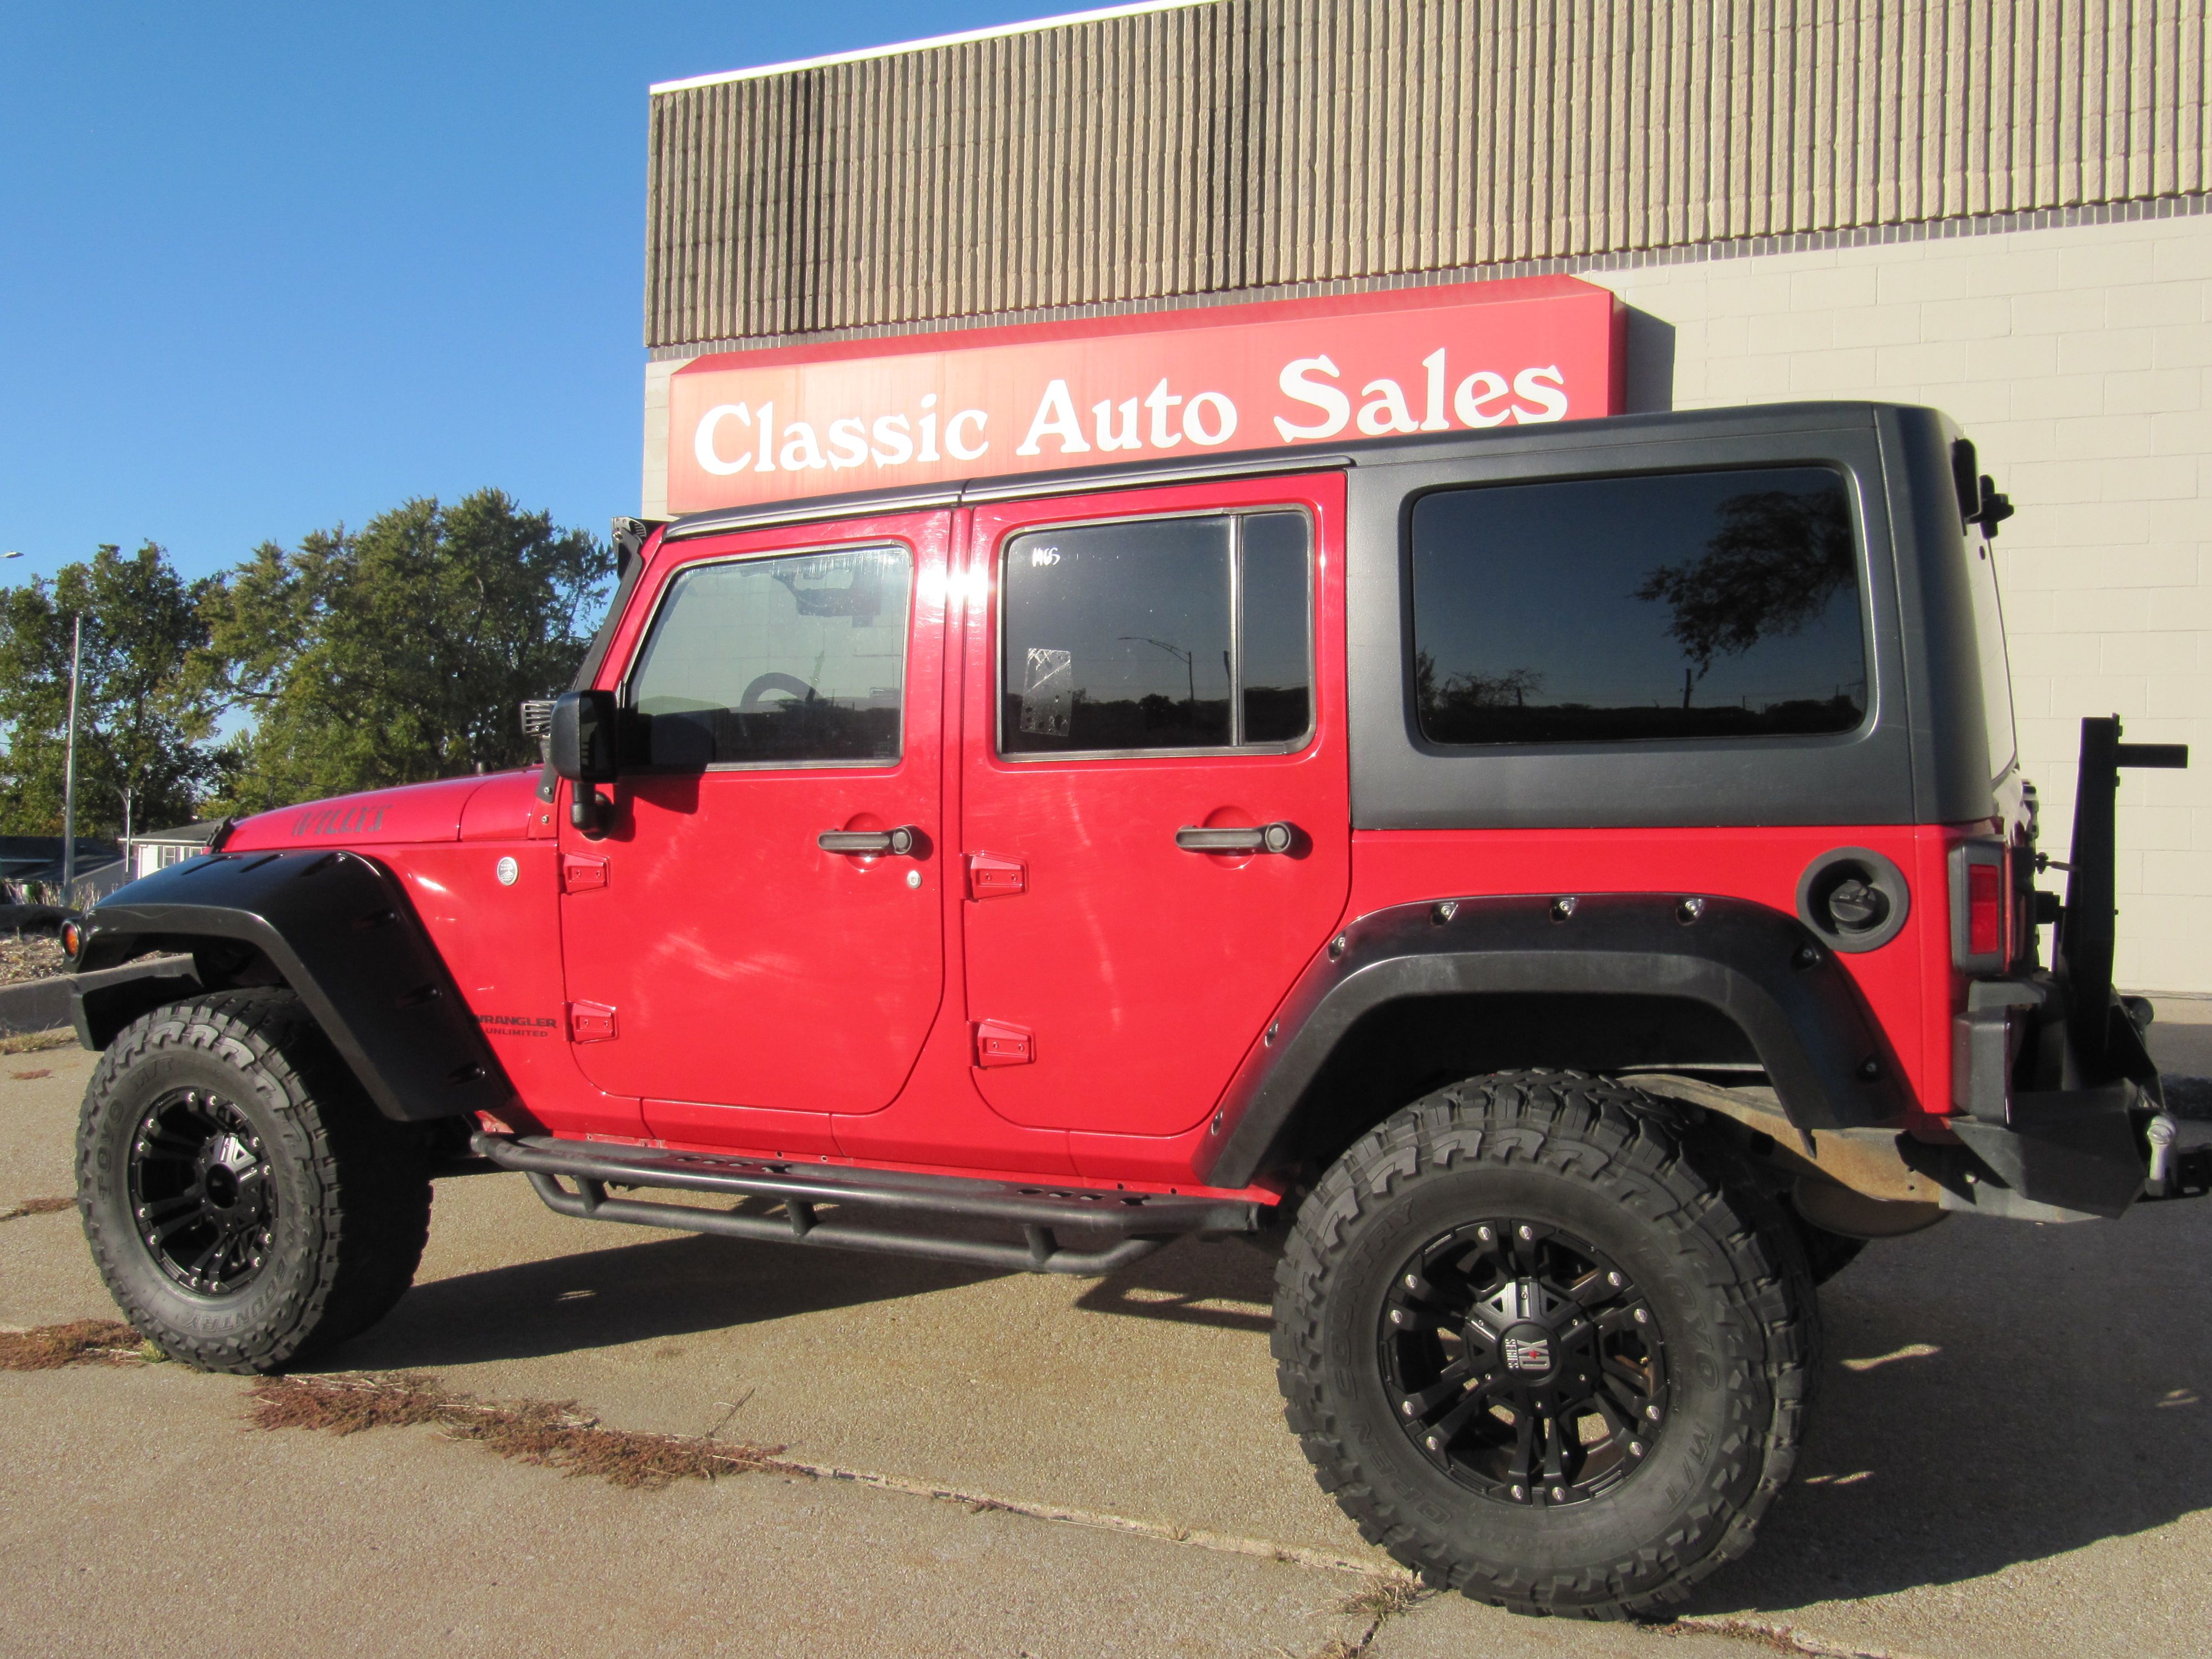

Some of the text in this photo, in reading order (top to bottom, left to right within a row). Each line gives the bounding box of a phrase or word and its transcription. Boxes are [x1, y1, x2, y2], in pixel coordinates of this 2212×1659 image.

[694, 347, 1568, 476] Classic Auto Sales
[484, 1027, 549, 1037] UNLIMITED
[1504, 1338, 1520, 1369] SERIES
[1516, 1338, 1551, 1370] XD
